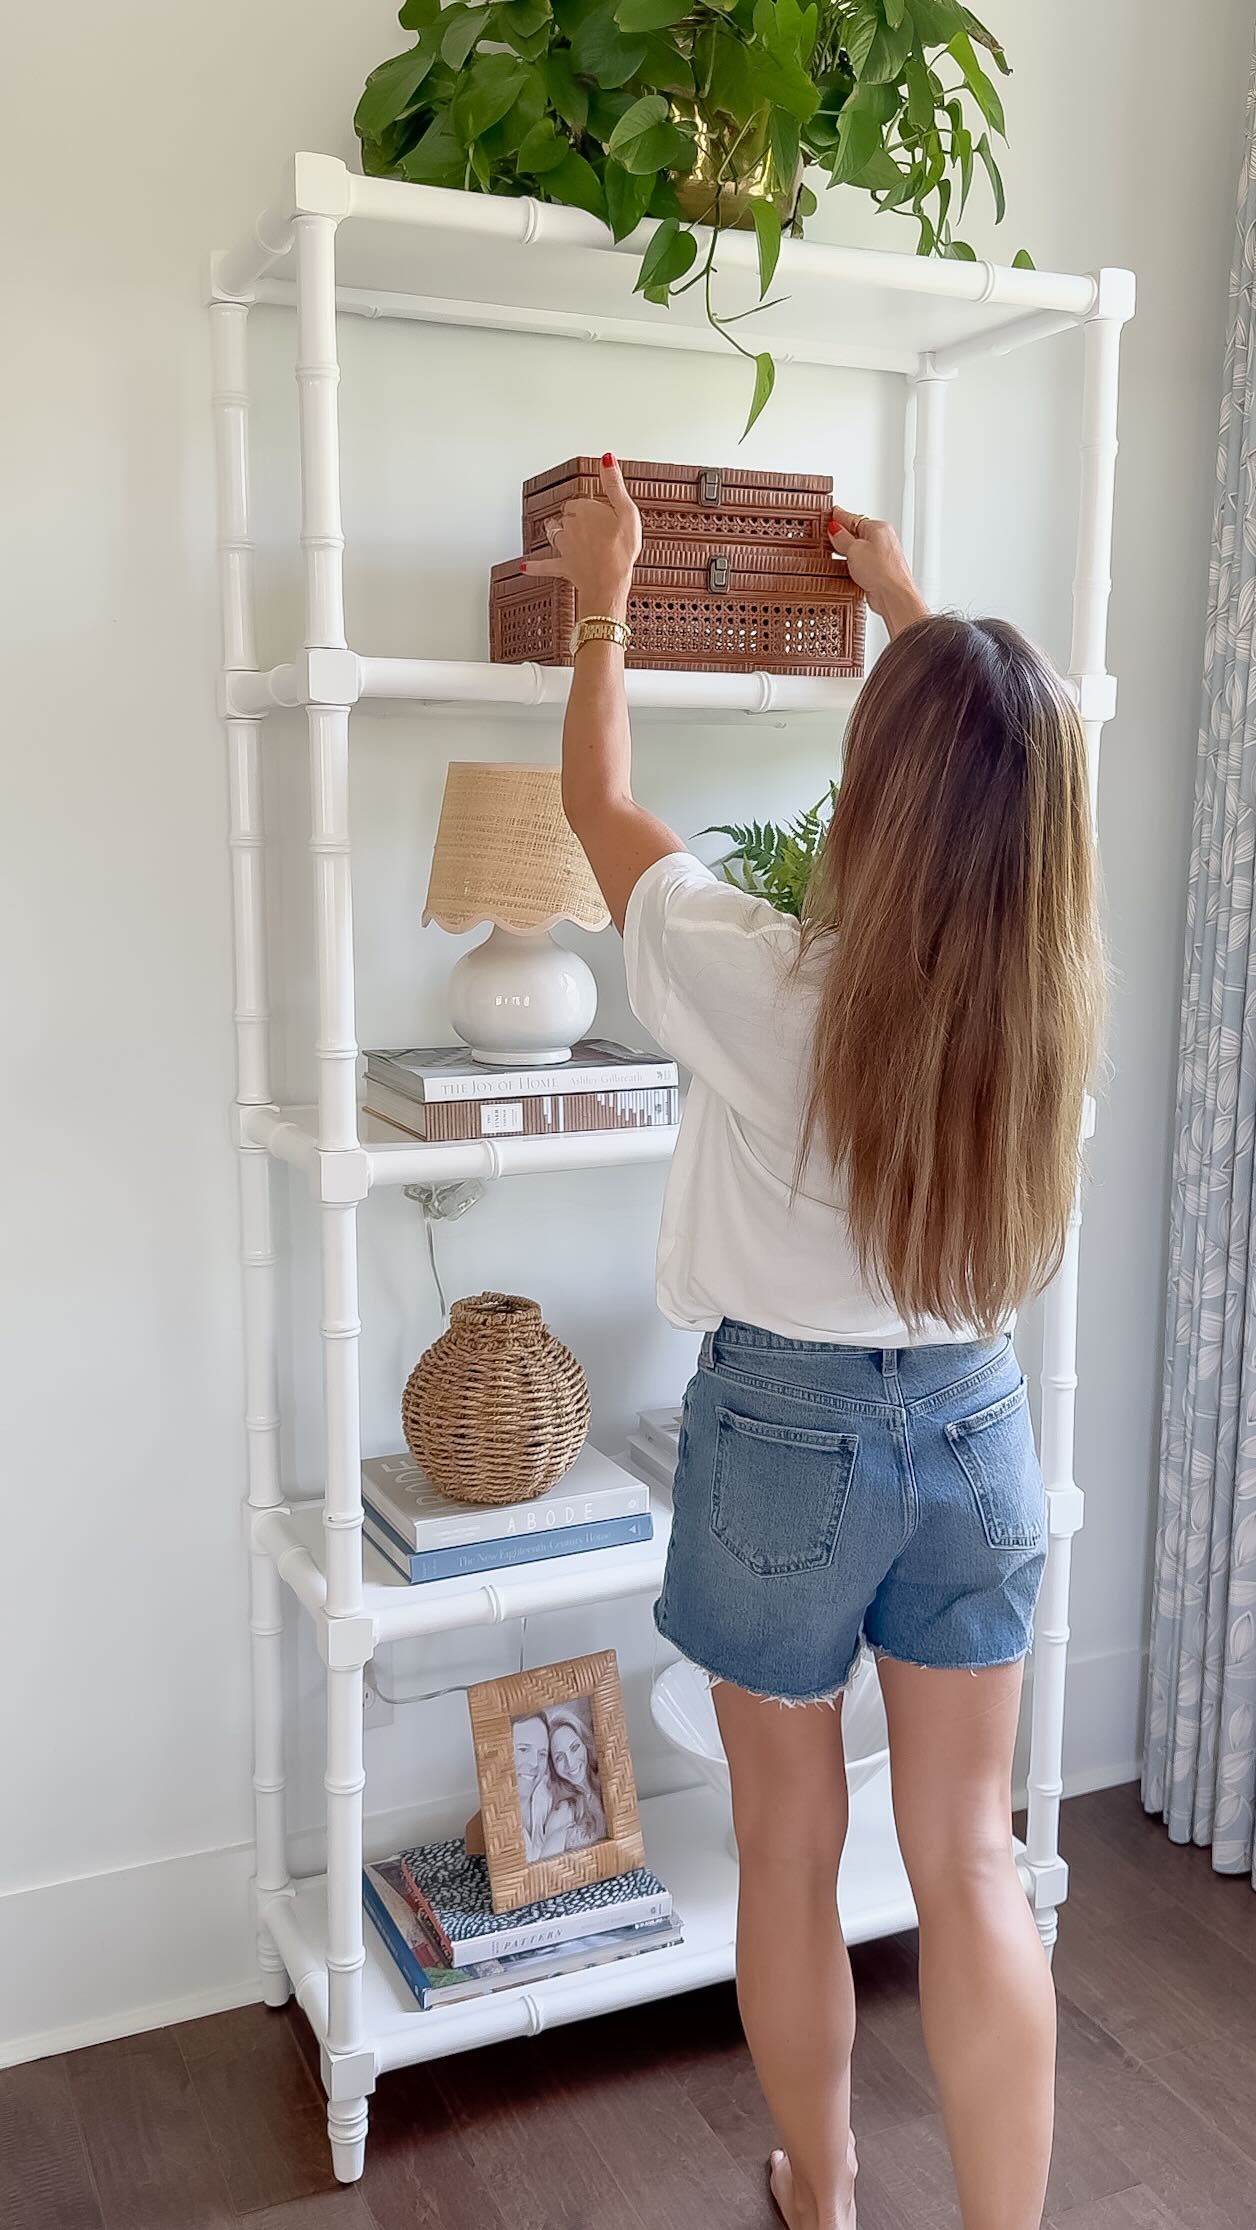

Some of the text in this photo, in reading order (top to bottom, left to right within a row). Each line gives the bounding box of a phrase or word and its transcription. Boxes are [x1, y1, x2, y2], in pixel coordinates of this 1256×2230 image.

[441, 1076, 559, 1095] THE JOY OF HOME
[506, 1502, 594, 1534] ABODE
[503, 1928, 563, 1950] PATTERN
